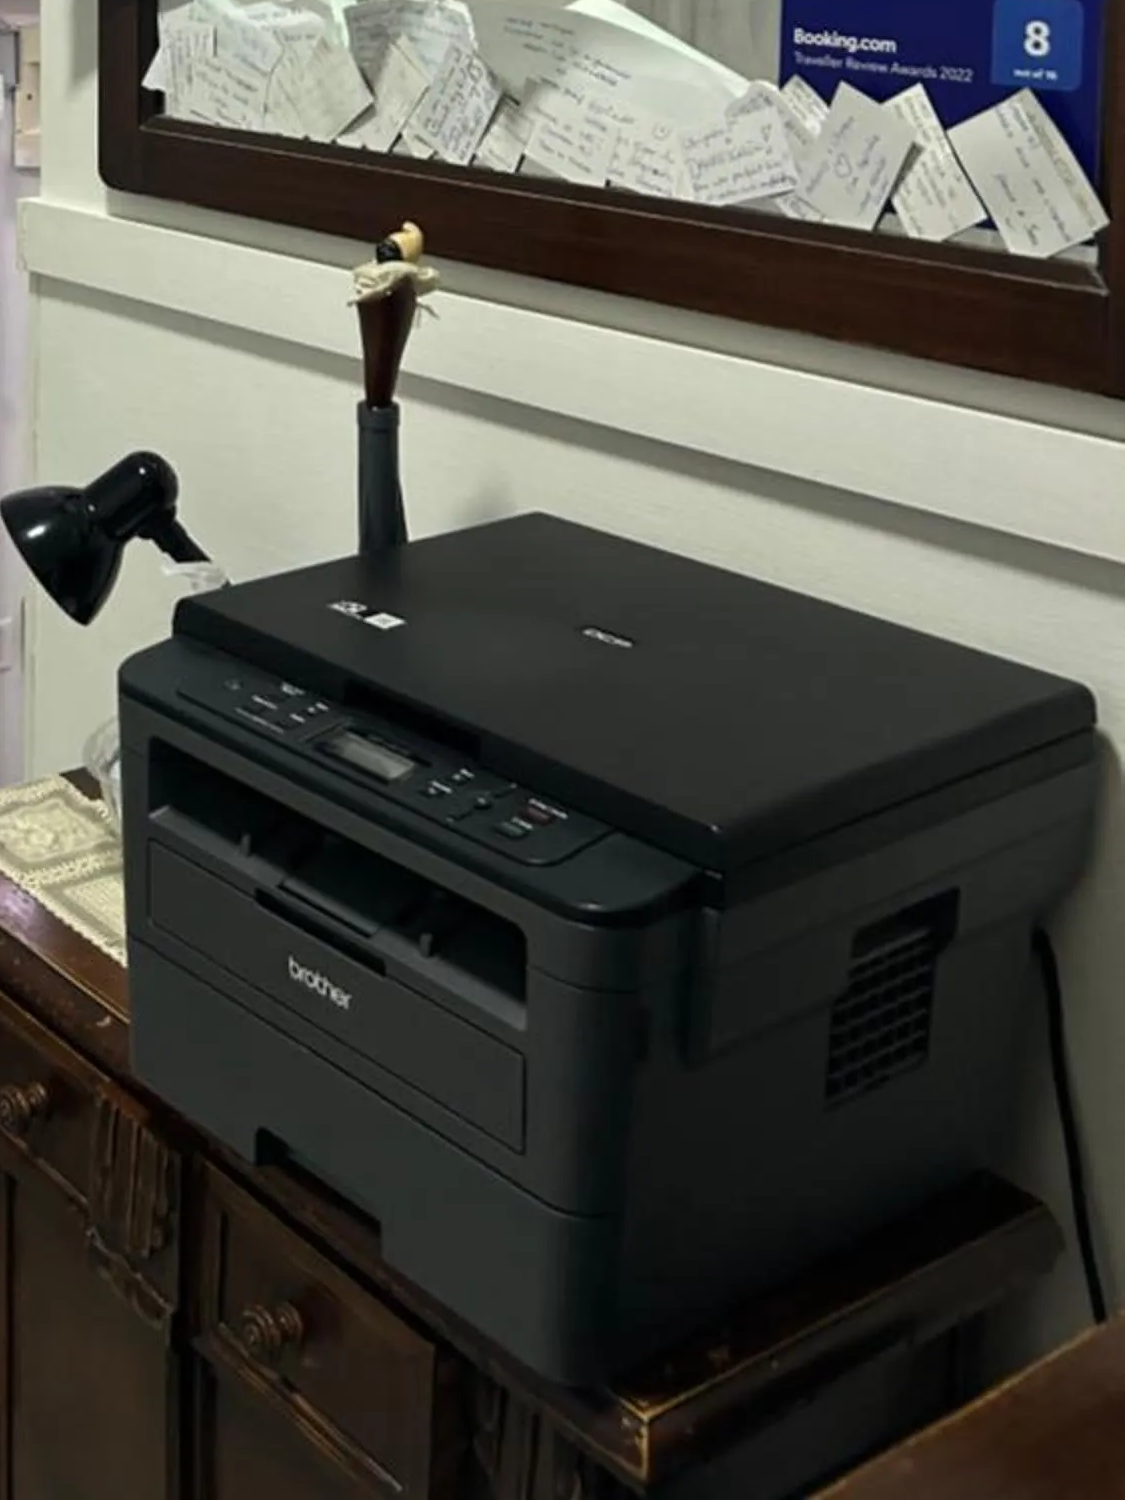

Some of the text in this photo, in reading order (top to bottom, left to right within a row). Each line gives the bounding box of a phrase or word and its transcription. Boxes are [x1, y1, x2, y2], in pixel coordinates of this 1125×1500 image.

[793, 27, 897, 54] Booking.com
[1023, 20, 1051, 57] 8
[845, 56, 889, 74] Review
[890, 61, 937, 80] Awards
[939, 66, 974, 83] 2022
[288, 953, 353, 1010] brother
